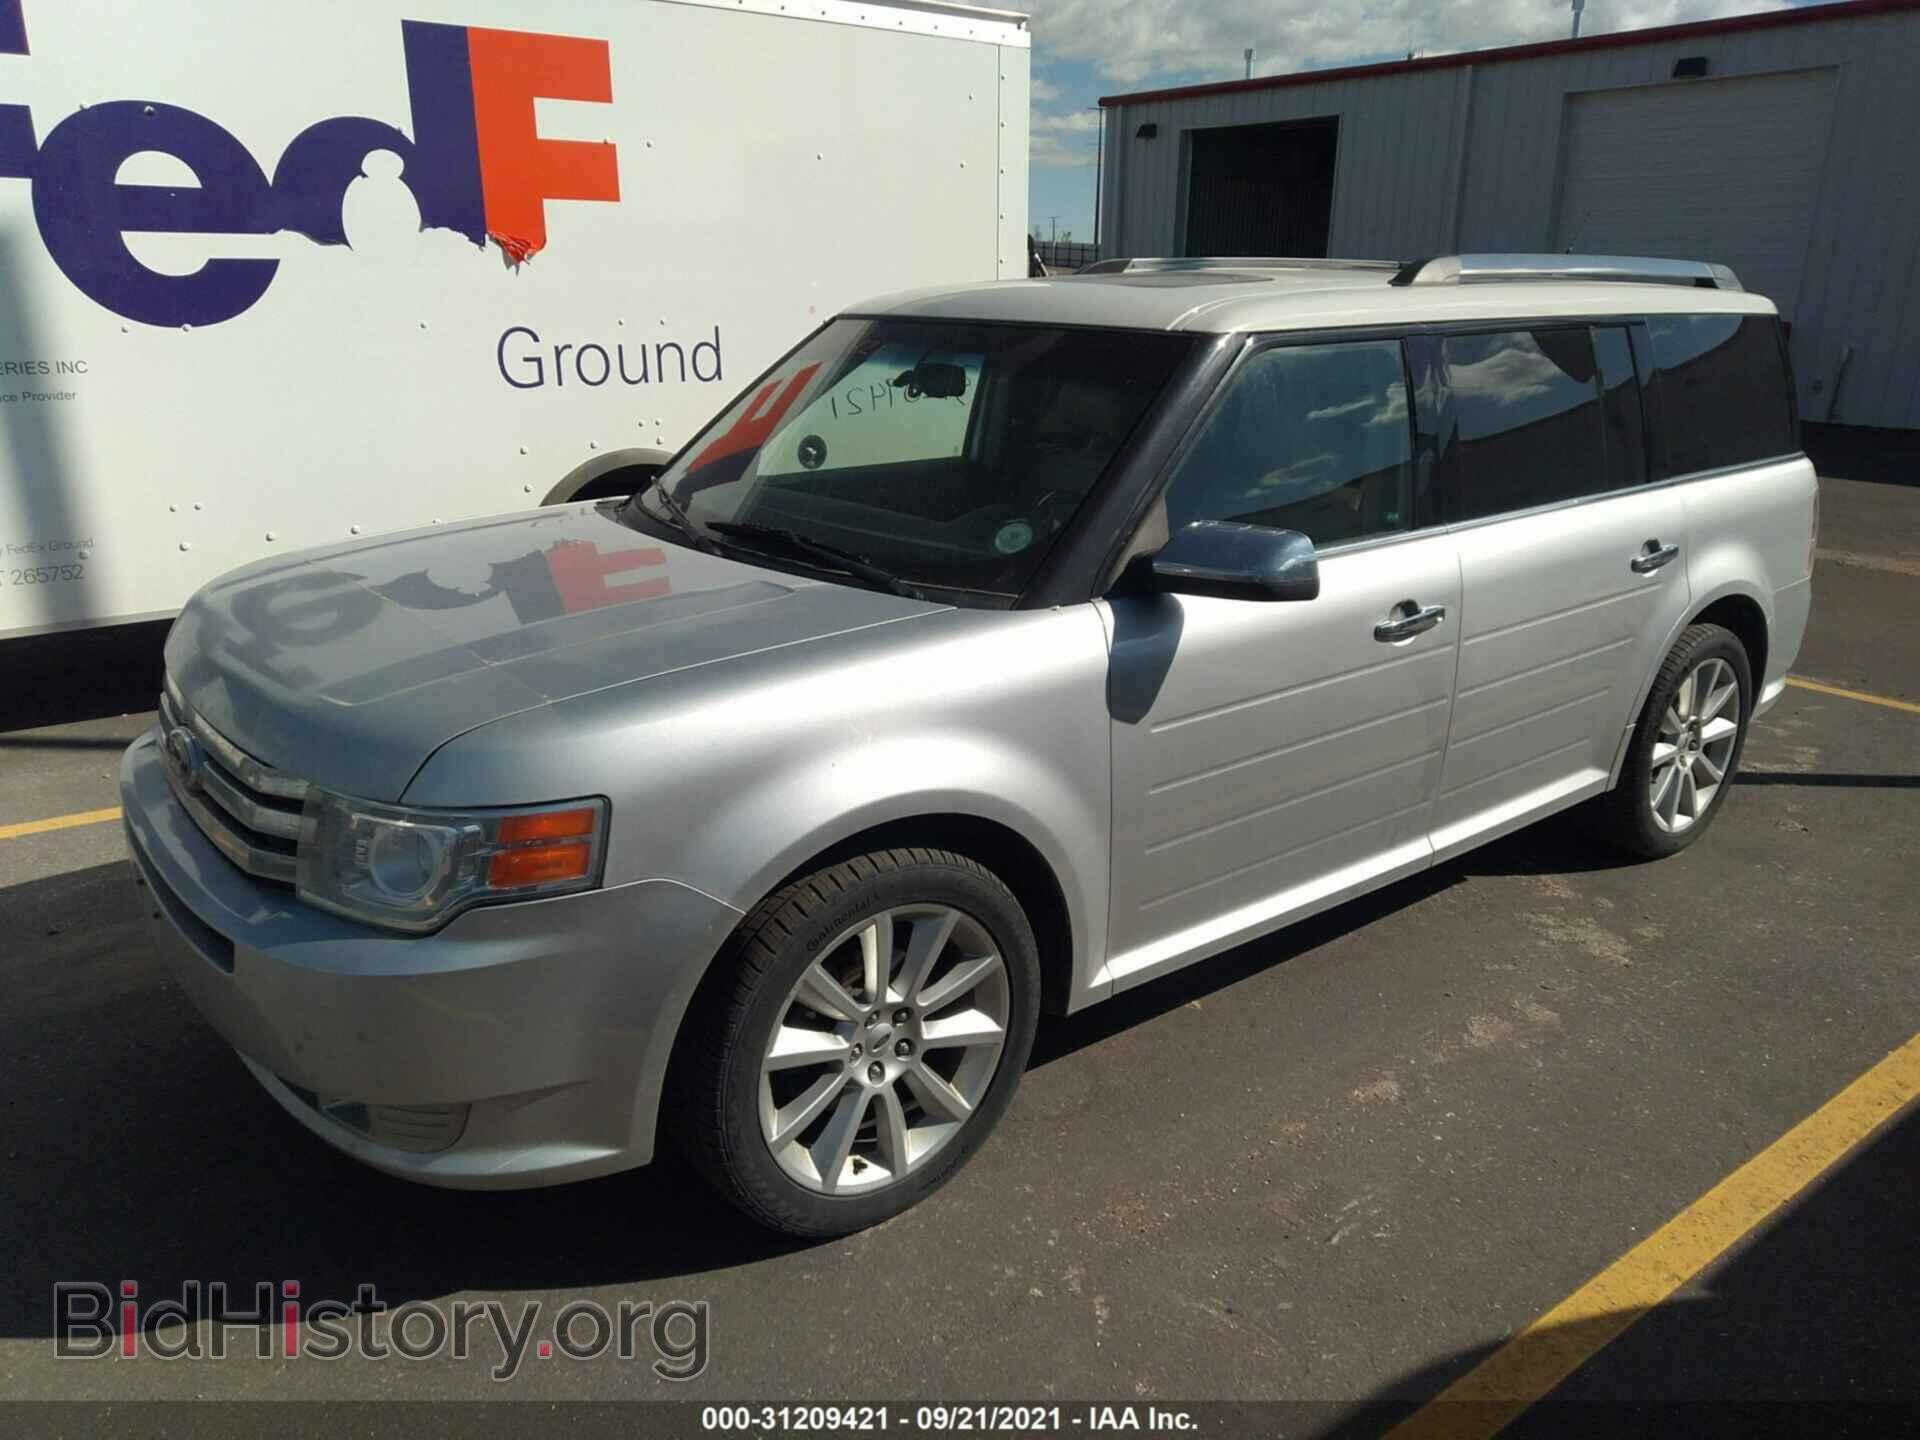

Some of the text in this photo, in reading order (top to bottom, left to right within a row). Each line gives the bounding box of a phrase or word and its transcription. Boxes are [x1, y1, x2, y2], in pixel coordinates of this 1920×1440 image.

[497, 325, 722, 389] Ground
[56, 360, 89, 374] INC
[22, 391, 76, 401] Provider
[7, 542, 48, 555] FedEx
[49, 538, 95, 553] Ground
[11, 564, 85, 586] 265752
